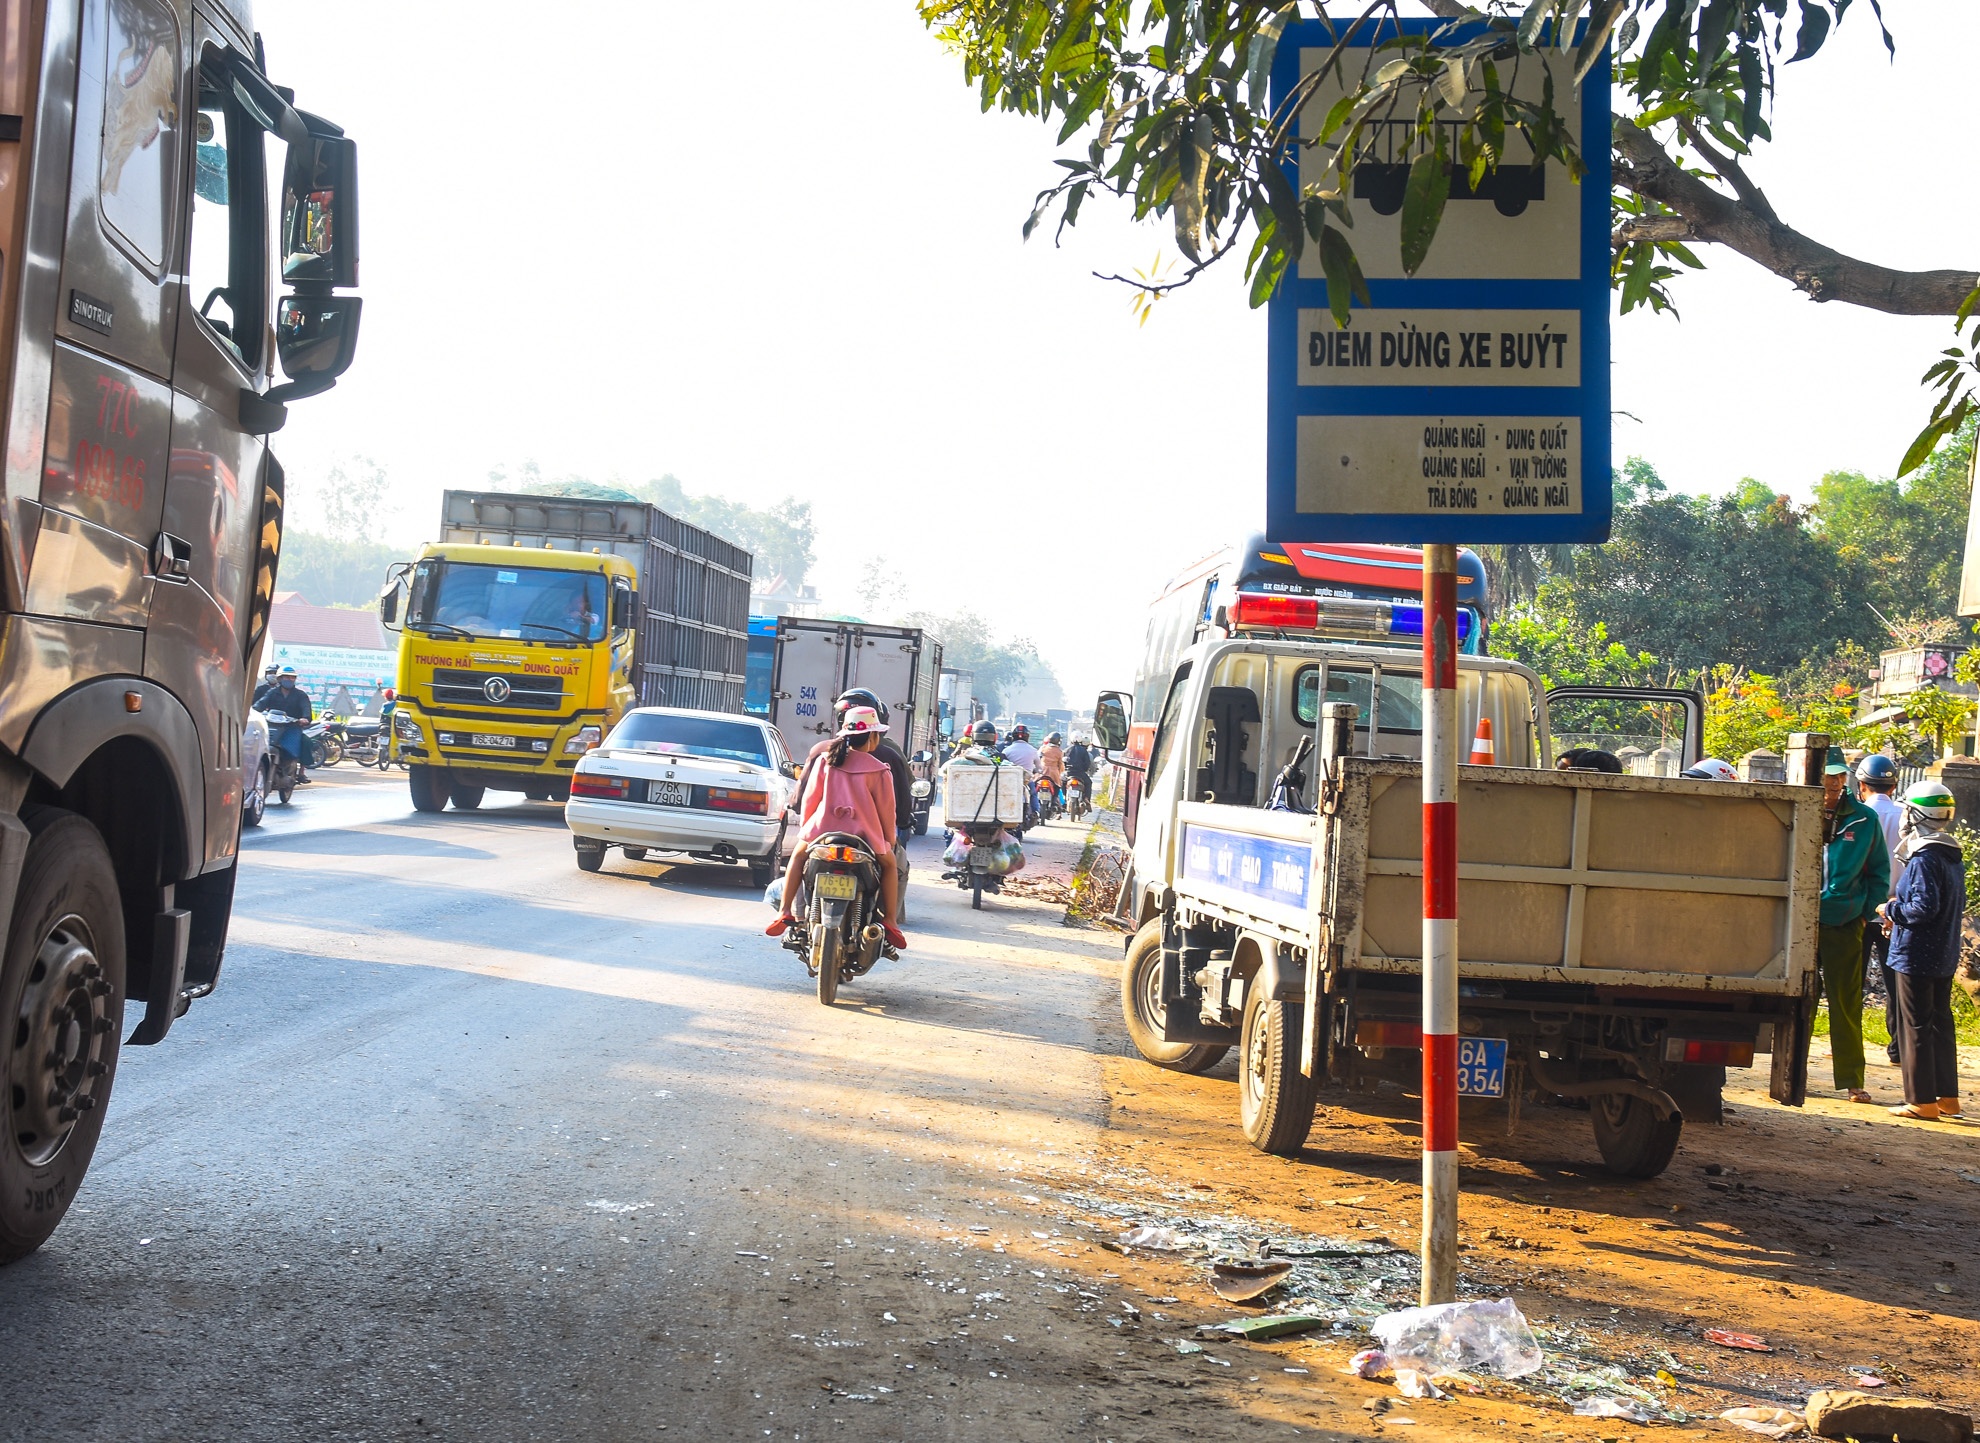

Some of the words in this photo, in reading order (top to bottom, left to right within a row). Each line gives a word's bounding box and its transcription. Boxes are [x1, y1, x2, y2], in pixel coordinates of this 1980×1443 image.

[74, 298, 113, 328] SINOTRUK
[1380, 321, 1450, 368] DỪNG
[1458, 332, 1492, 368] XE
[1500, 323, 1568, 369] BUÝT
[96, 374, 140, 440] 77C
[1424, 418, 1459, 449] QUẢNG
[1461, 423, 1486, 449] NGÃI
[1506, 429, 1536, 450] DUNG
[1540, 422, 1568, 451] QUẤT
[1422, 449, 1458, 479] QUẢNG
[1509, 457, 1529, 484] VẠN
[1449, 480, 1478, 508] BỒNG
[1503, 480, 1539, 509] QUẢNG
[1544, 482, 1570, 508] NGÃI
[524, 663, 550, 674] DUNG
[800, 686, 817, 700] 54X
[795, 702, 817, 717] 8400
[655, 792, 684, 806] 7909
[659, 781, 680, 794] 76K
[1241, 854, 1262, 885] GIAO
[1460, 1041, 1487, 1066] 6A
